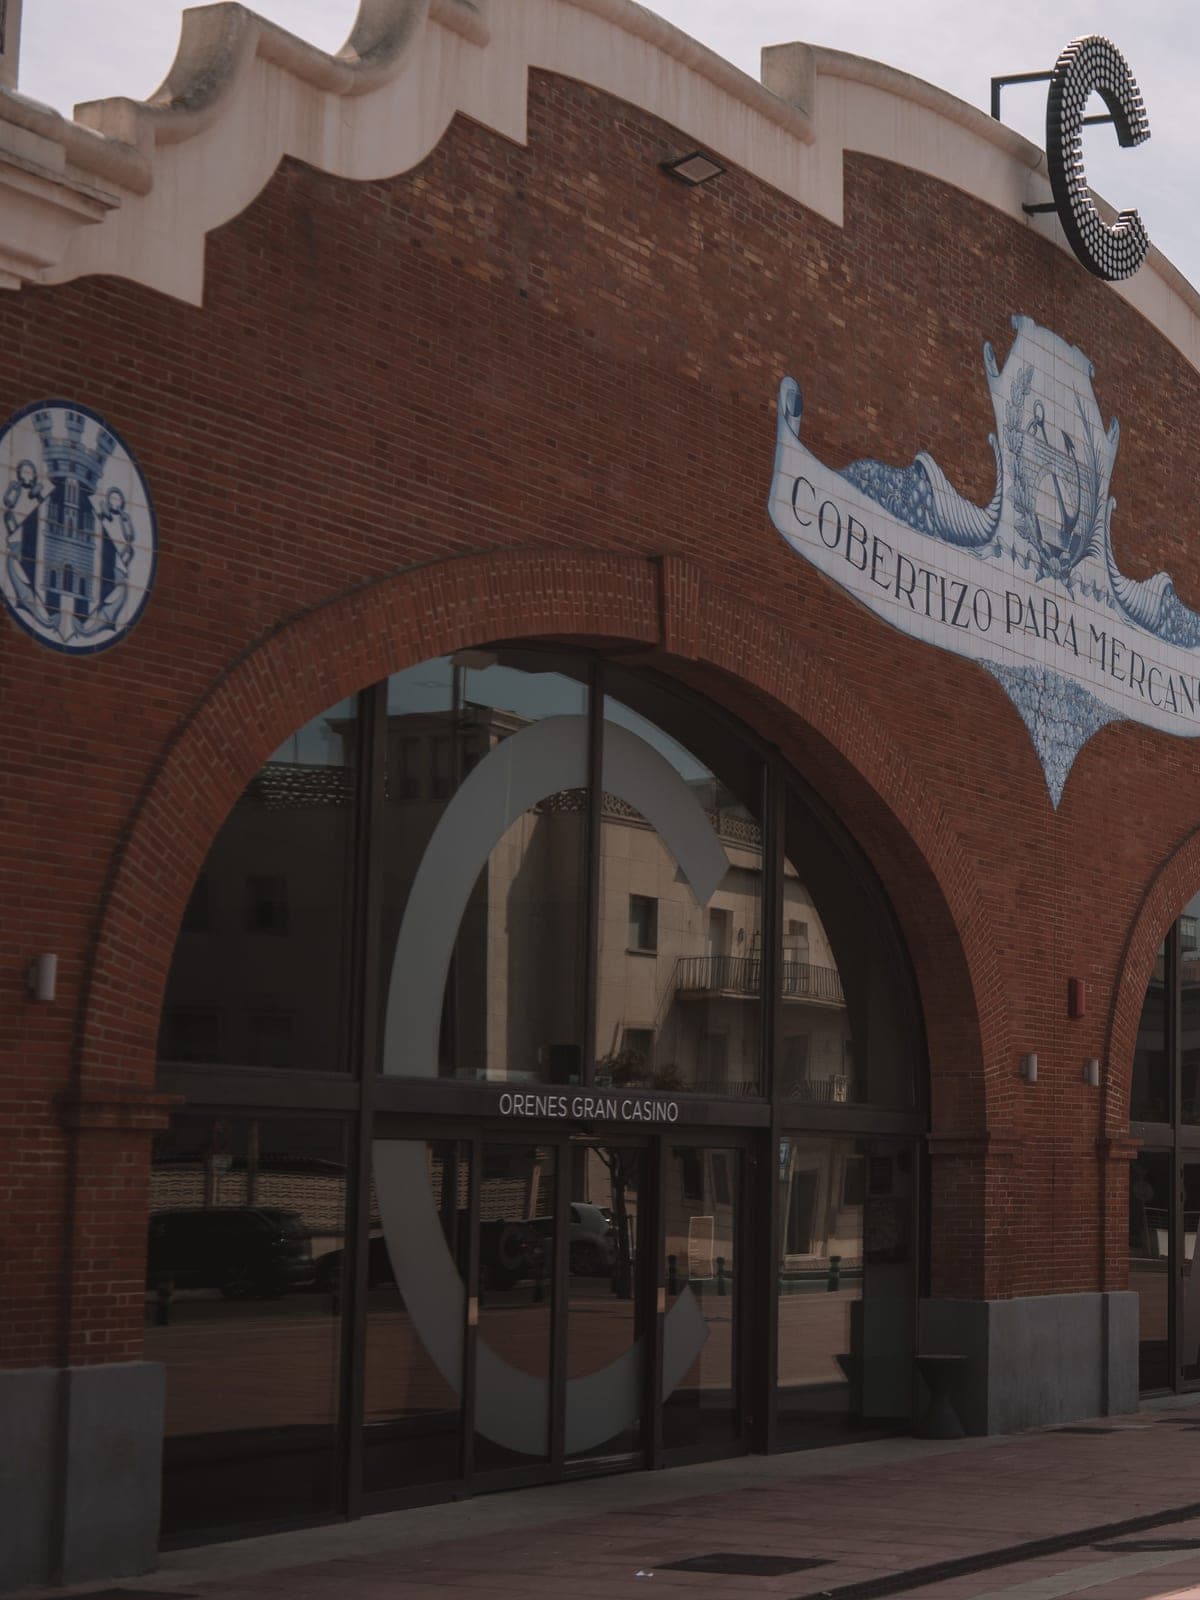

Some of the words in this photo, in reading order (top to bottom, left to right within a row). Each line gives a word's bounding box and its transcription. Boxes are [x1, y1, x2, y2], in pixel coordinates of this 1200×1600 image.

[1047, 34, 1150, 281] C
[791, 475, 993, 633] COBERTIZO
[1005, 590, 1080, 658] PARA
[499, 1093, 567, 1118] ORENES
[571, 1097, 618, 1120] GRAN
[621, 1099, 679, 1122] CASINO
